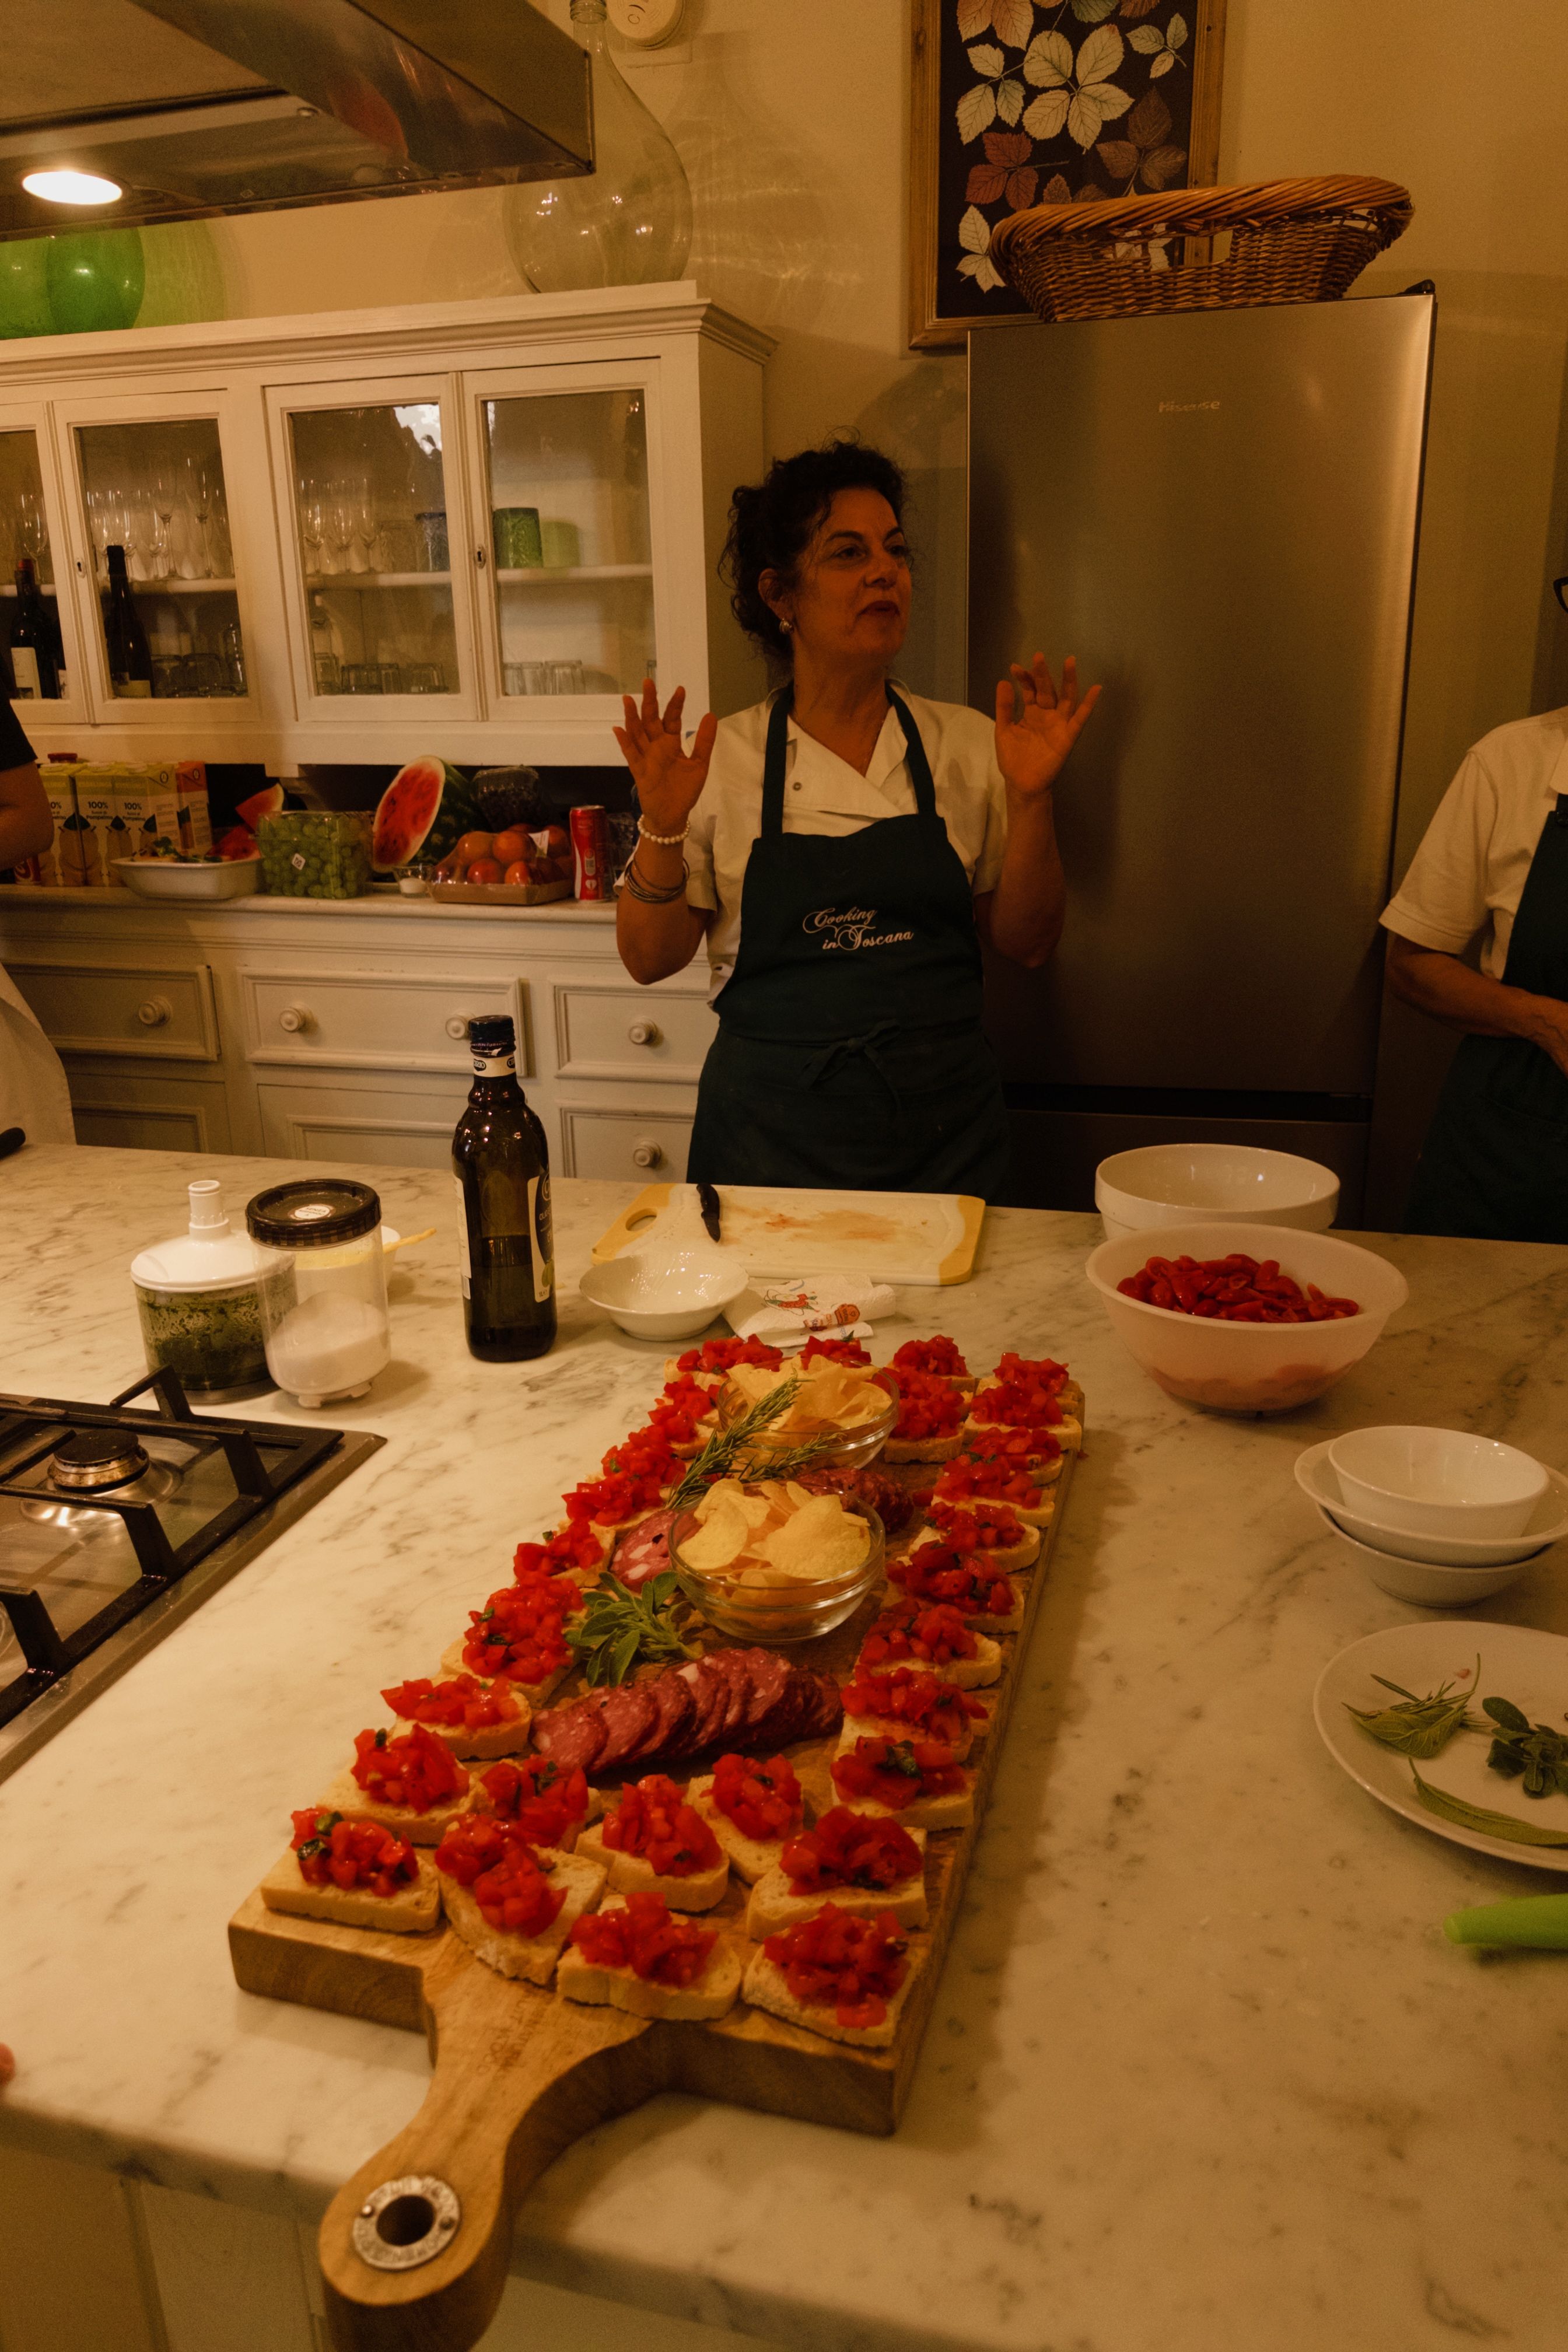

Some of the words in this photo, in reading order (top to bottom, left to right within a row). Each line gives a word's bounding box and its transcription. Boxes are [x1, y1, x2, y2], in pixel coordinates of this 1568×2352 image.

[1158, 401, 1220, 412] Hisense
[124, 802, 142, 810] 100%
[802, 906, 878, 934] Cooking
[822, 939, 838, 950] in
[836, 923, 914, 951] Toscana
